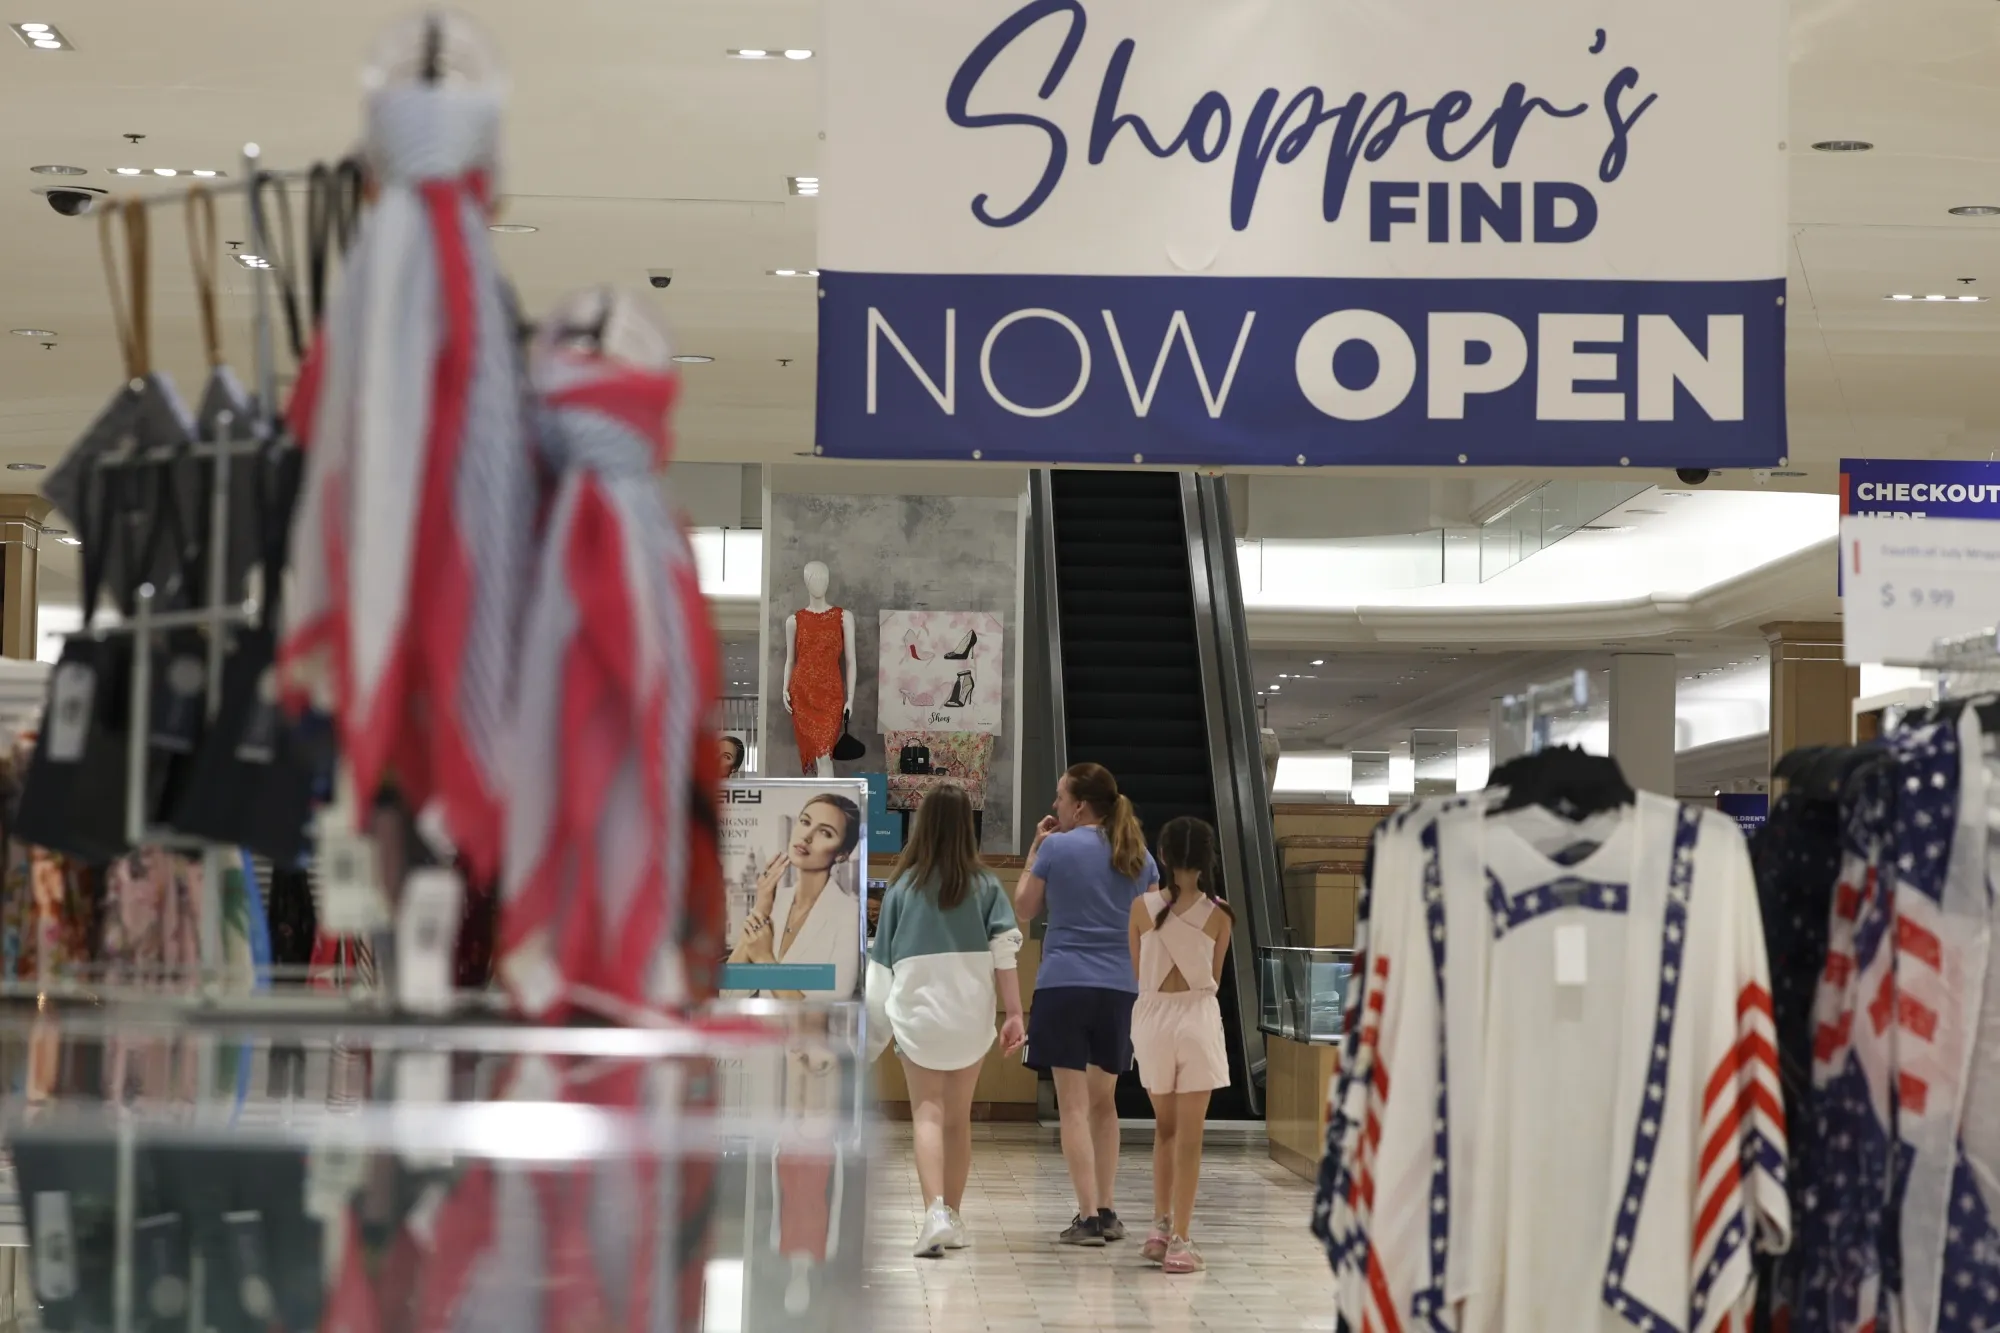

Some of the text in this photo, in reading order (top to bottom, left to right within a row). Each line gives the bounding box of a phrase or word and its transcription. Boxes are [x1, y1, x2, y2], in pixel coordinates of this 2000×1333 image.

[945, 0, 1658, 232] Shopper's
[1369, 180, 1599, 244] FIND
[866, 306, 1745, 421] NOW OPEN
[1857, 482, 2000, 503] CHECKOUT
[927, 711, 951, 726] Shoes
